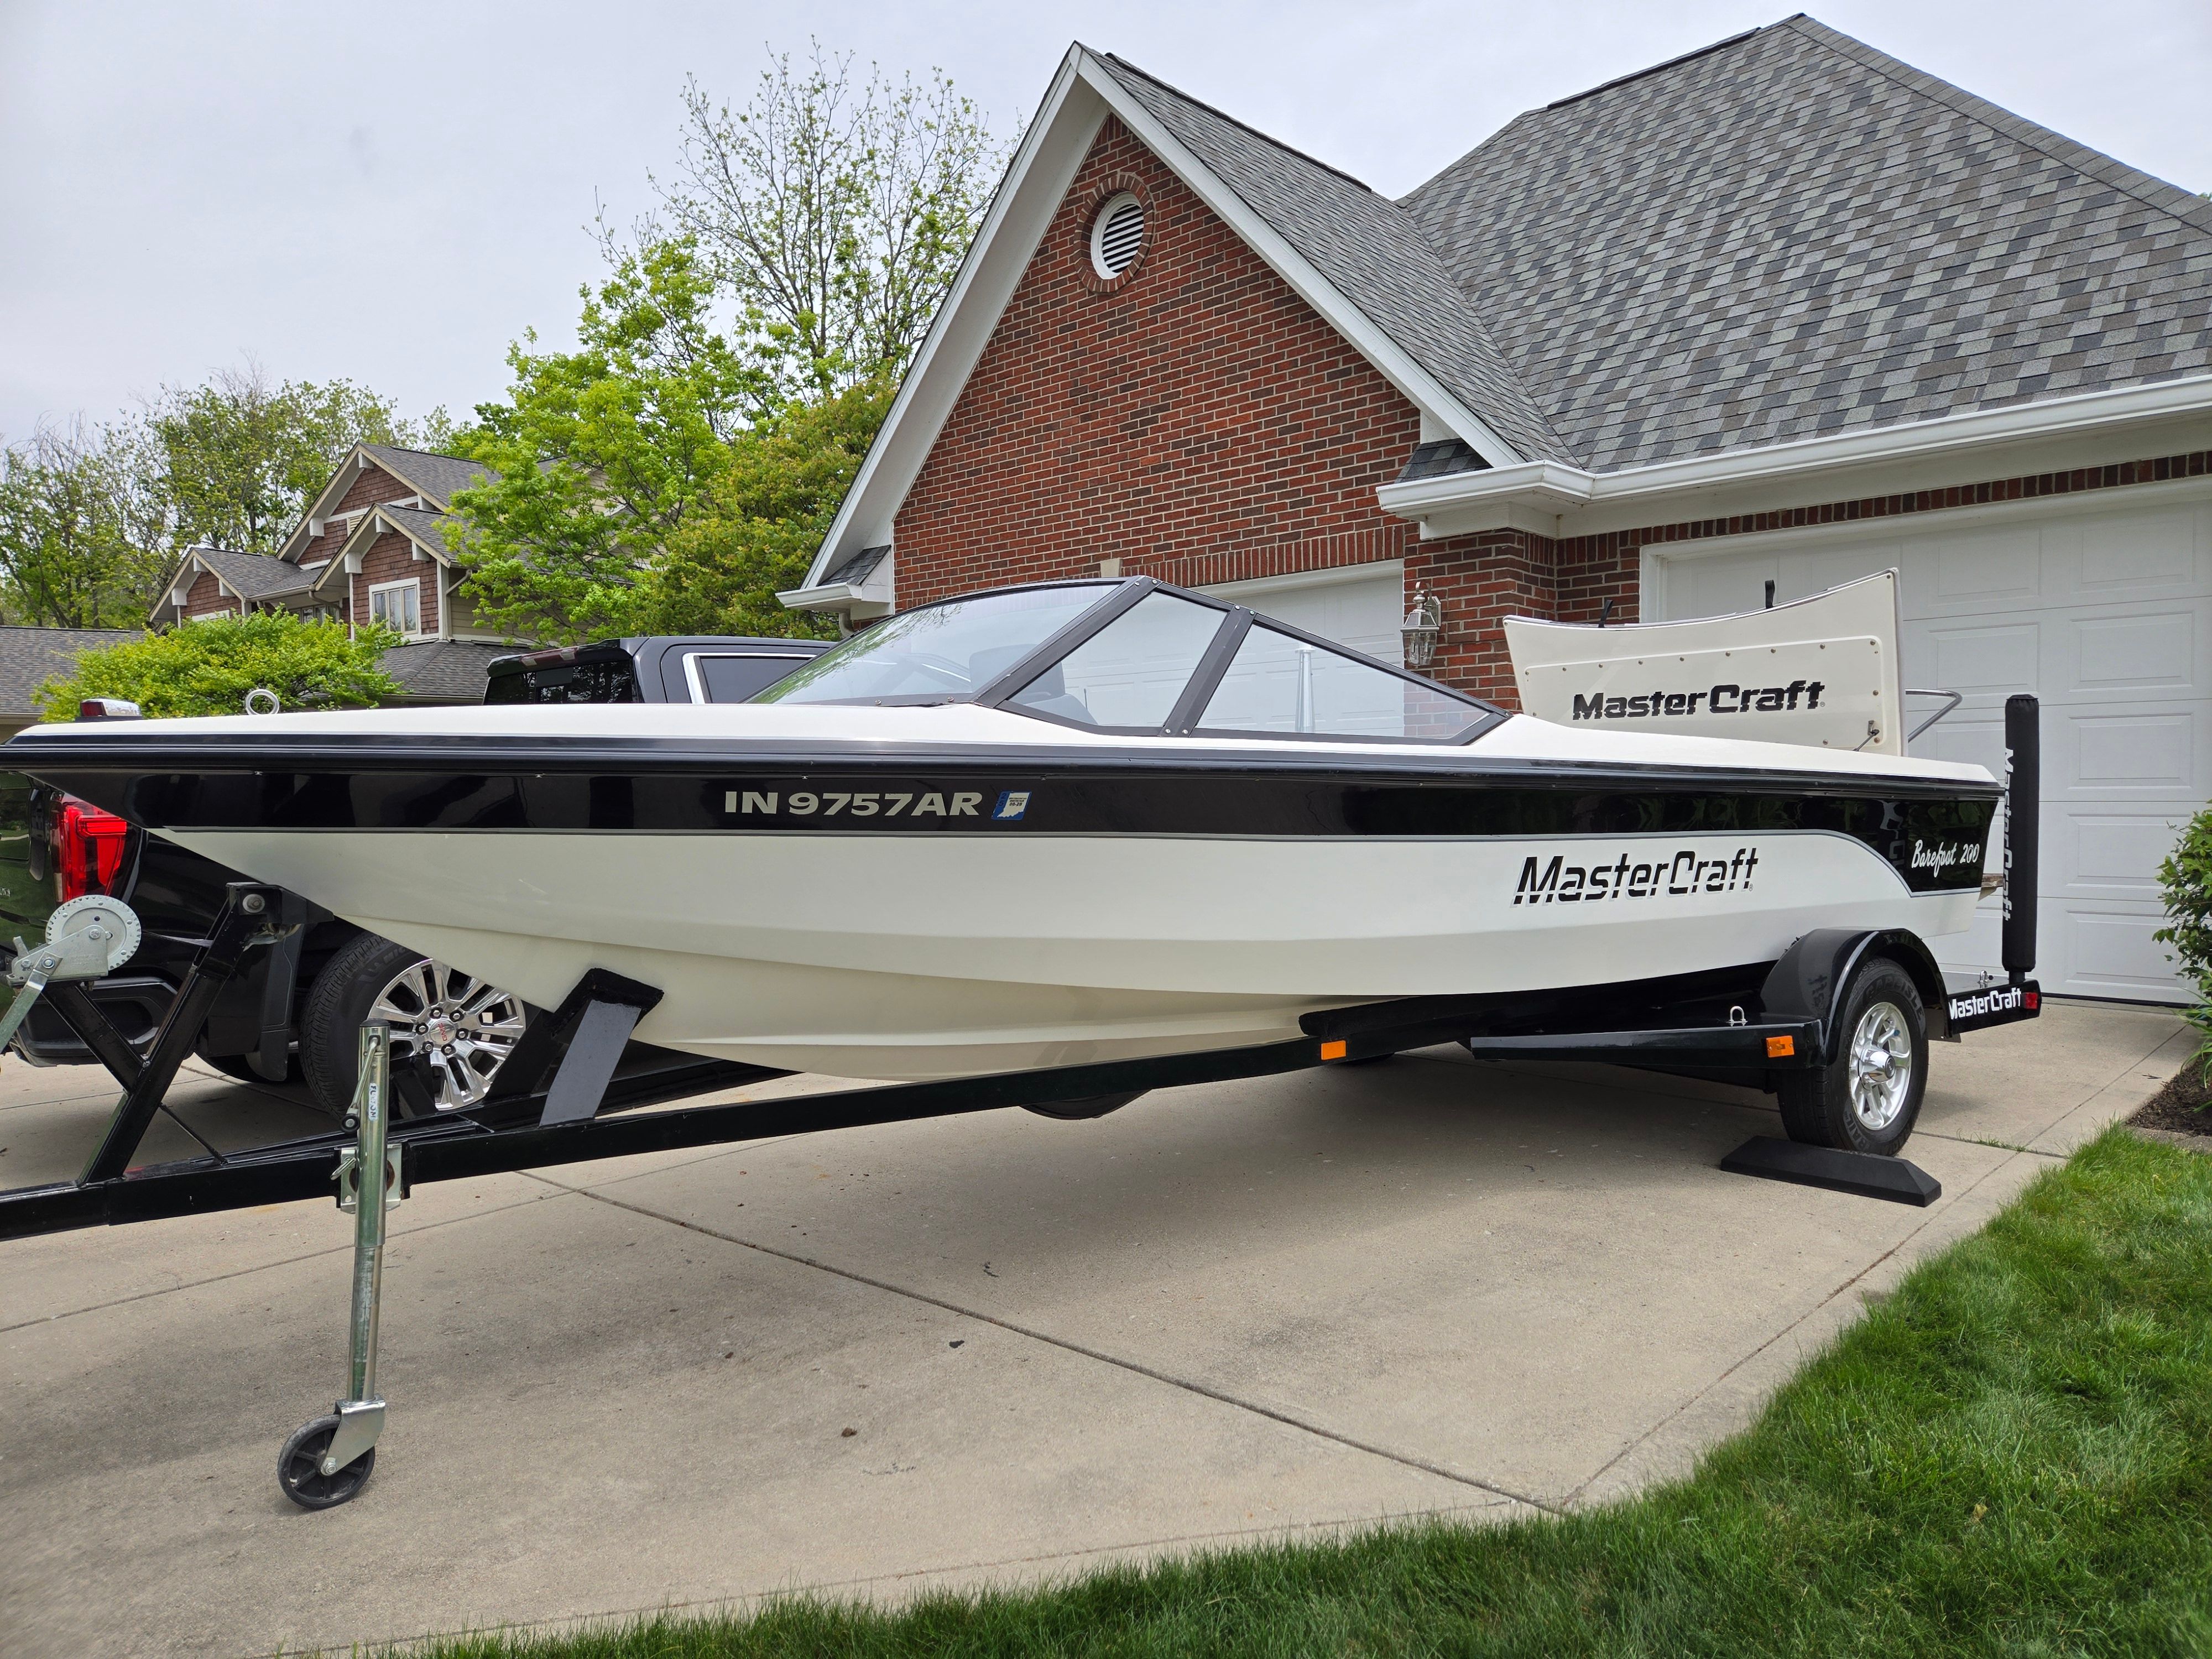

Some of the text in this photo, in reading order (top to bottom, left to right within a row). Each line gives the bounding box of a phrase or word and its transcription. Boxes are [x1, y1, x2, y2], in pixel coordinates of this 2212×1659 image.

[725, 791, 983, 816] IN 9757AR
[1959, 843, 1980, 863] 200
[1948, 987, 2022, 1020] MasterCraft
[437, 1022, 448, 1042] GMC
